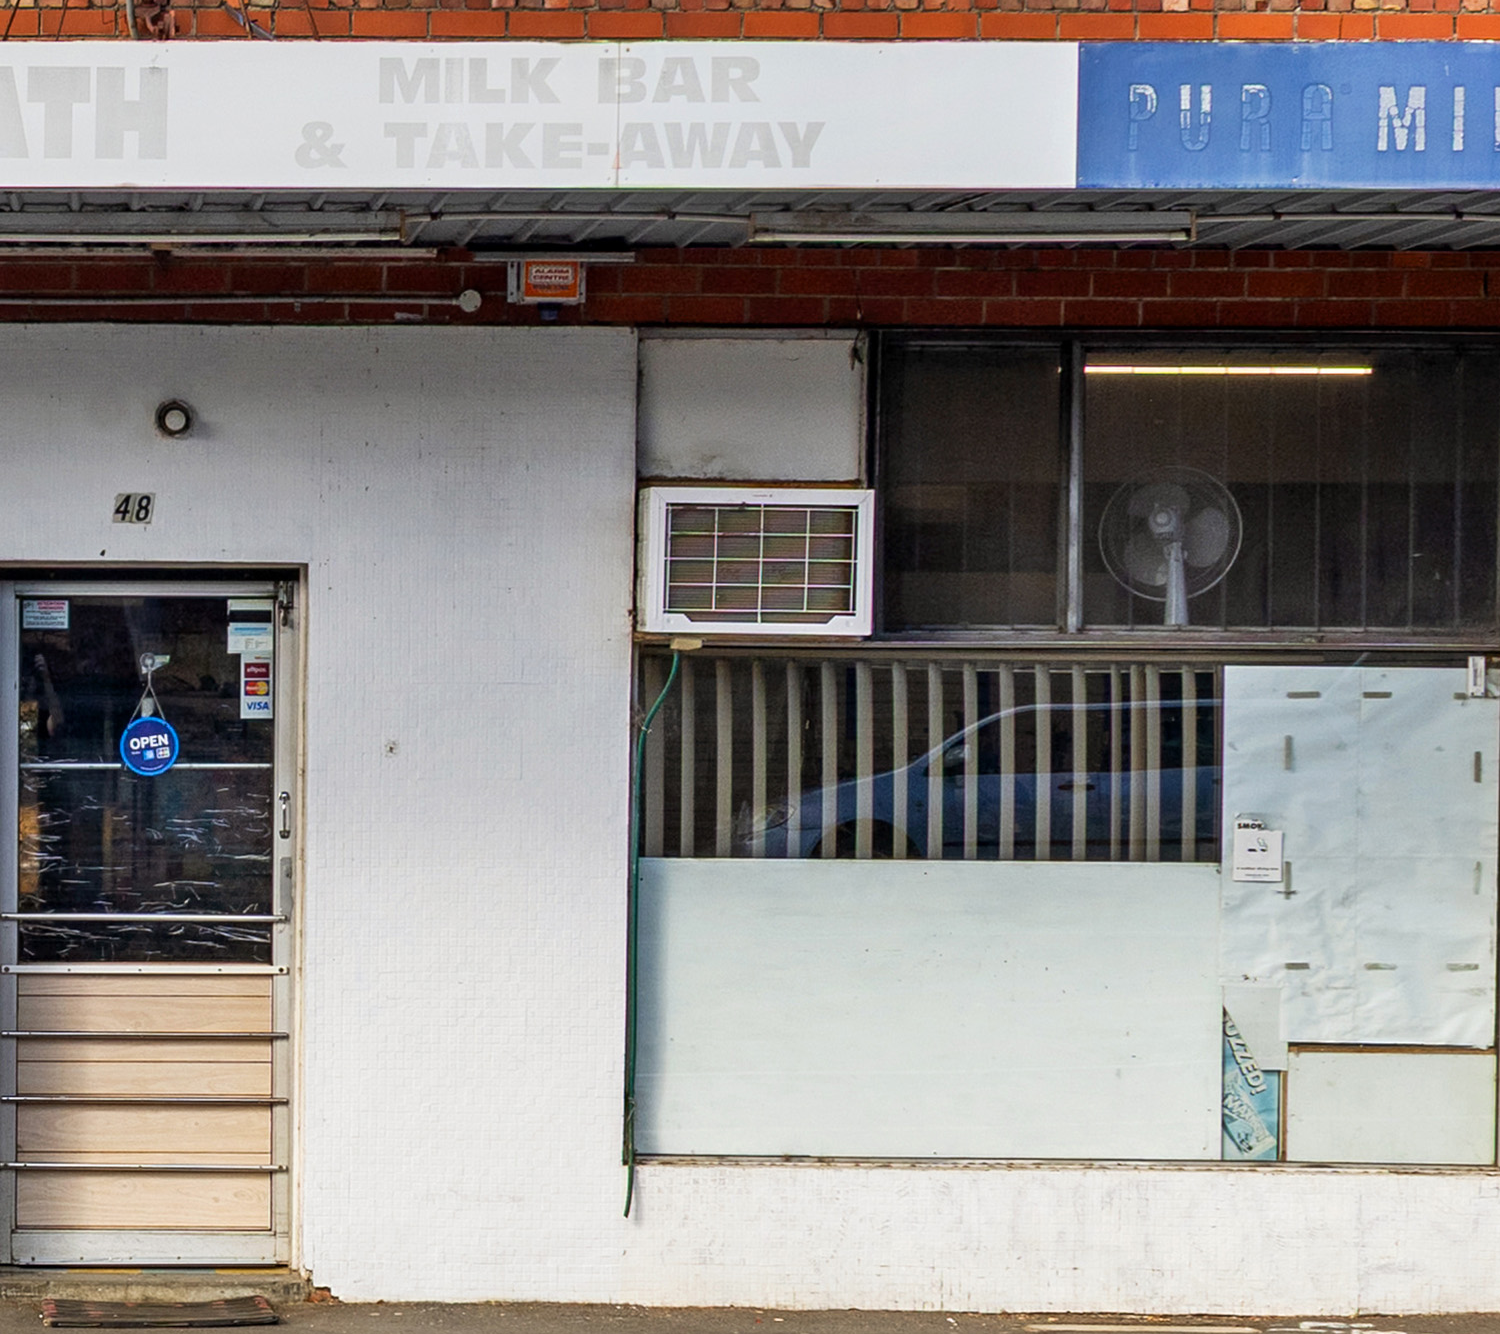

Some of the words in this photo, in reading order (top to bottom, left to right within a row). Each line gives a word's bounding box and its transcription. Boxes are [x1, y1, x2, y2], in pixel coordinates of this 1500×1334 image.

[378, 56, 563, 105] MILK
[604, 56, 761, 105] BAR
[1128, 83, 1334, 152] PURA
[294, 120, 348, 170] &
[383, 120, 826, 170] TAKE-AWAY
[114, 494, 152, 523] 48
[246, 701, 270, 710] VISA
[129, 733, 169, 750] OPEN
